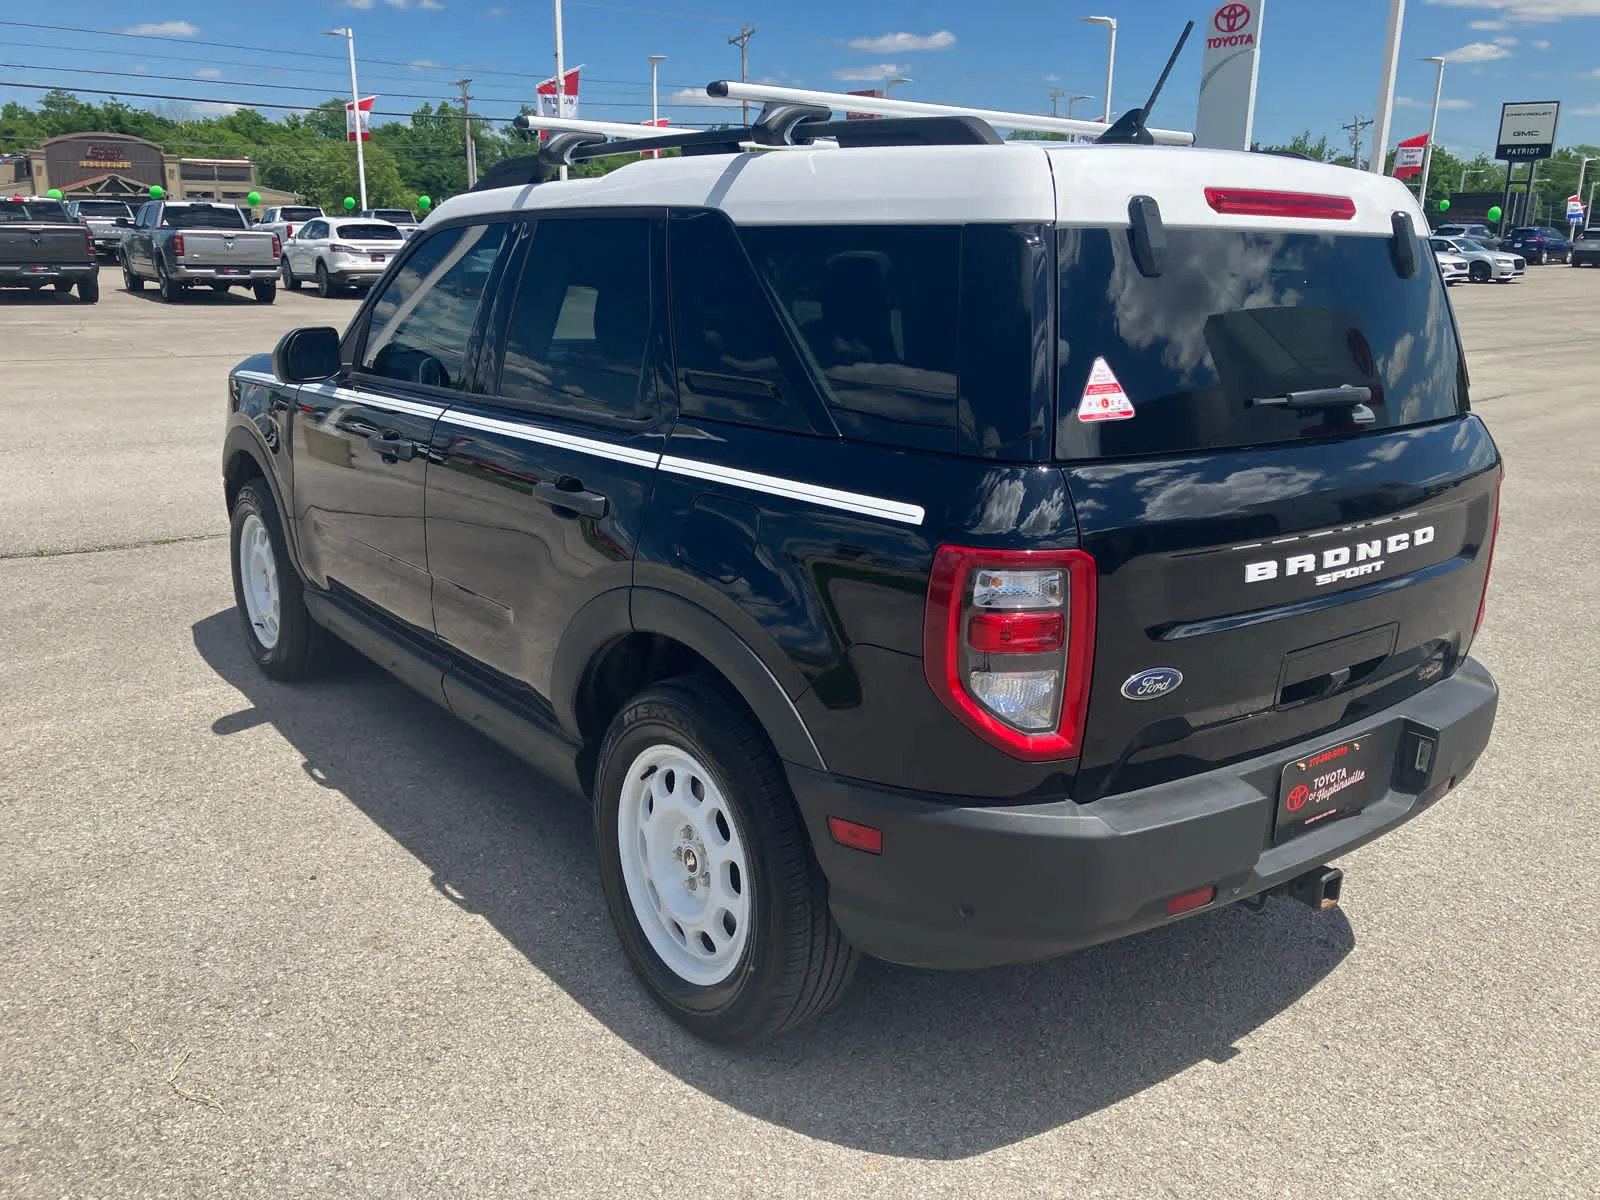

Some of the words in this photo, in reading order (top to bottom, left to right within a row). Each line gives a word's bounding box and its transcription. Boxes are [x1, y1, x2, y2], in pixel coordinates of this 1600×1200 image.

[1207, 34, 1254, 49] TOYOTA
[1506, 147, 1541, 155] PATRIOT
[1244, 525, 1435, 584] BRONCO
[1315, 560, 1385, 587] SPORT
[1137, 675, 1172, 695] Ford
[1313, 767, 1347, 790] TOYOTA
